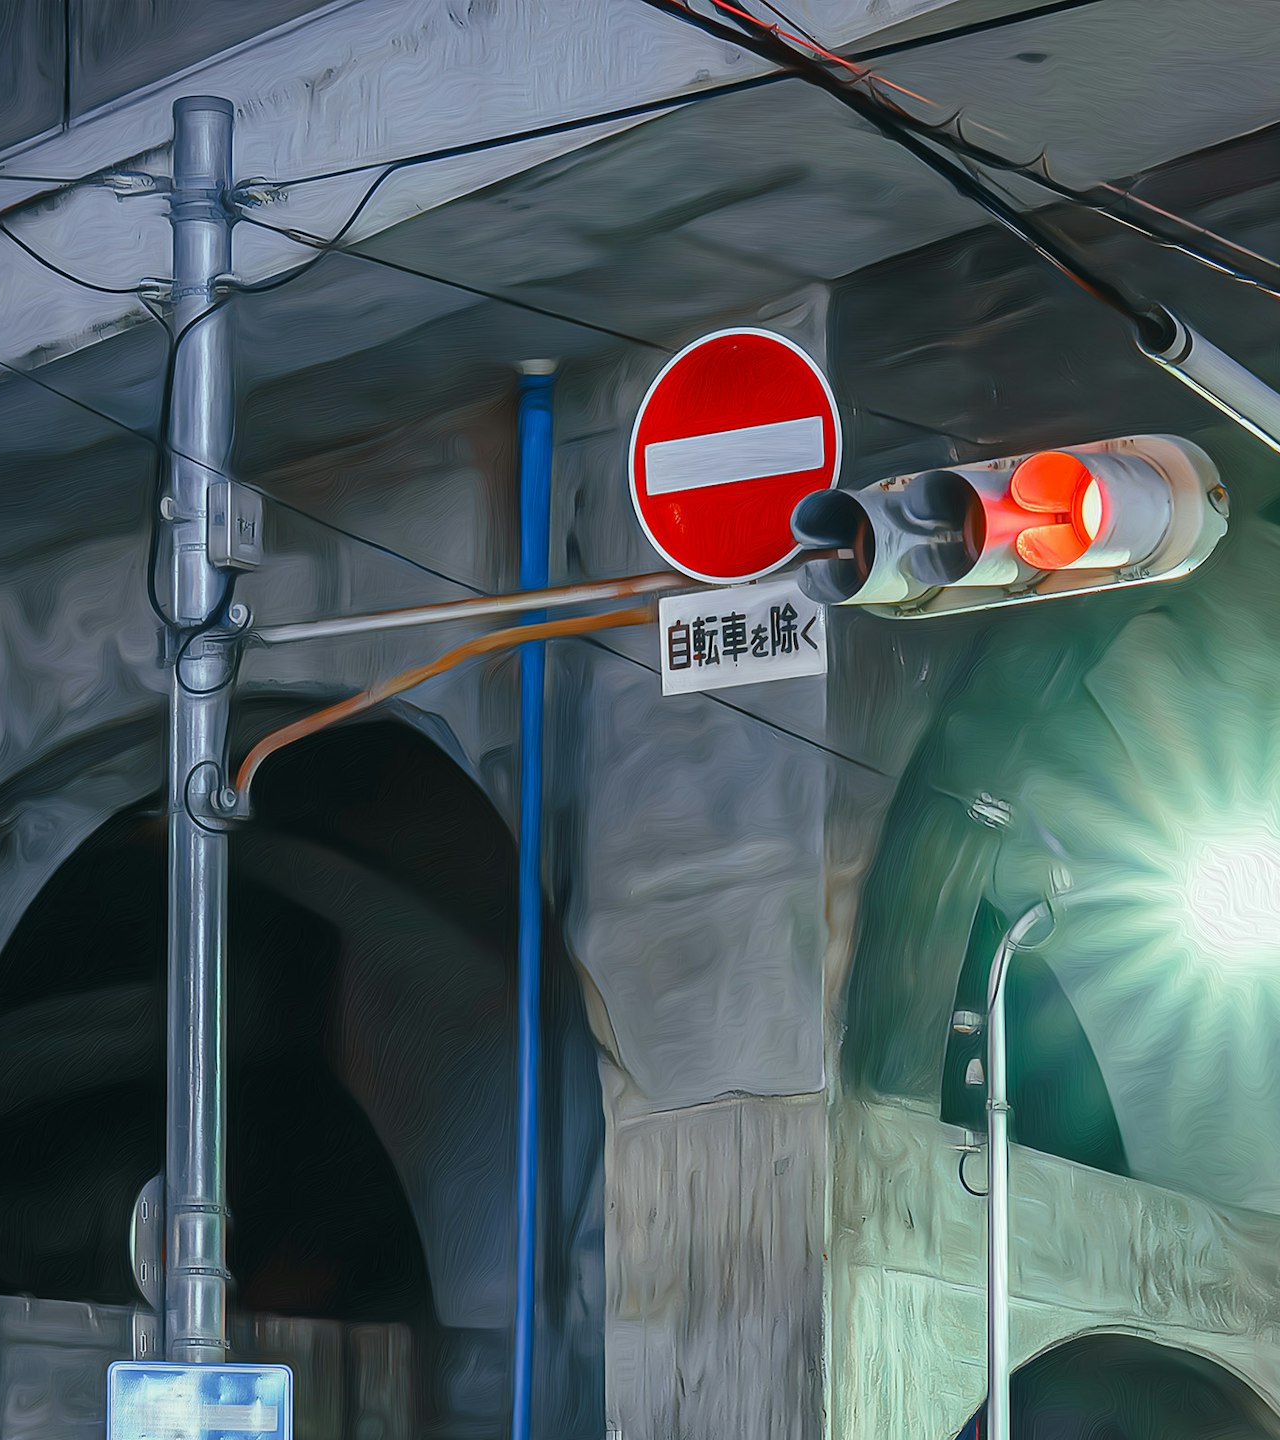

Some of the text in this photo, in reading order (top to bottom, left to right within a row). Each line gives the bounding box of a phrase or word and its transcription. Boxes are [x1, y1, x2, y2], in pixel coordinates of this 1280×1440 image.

[668, 602, 818, 671] 自転車を除く
